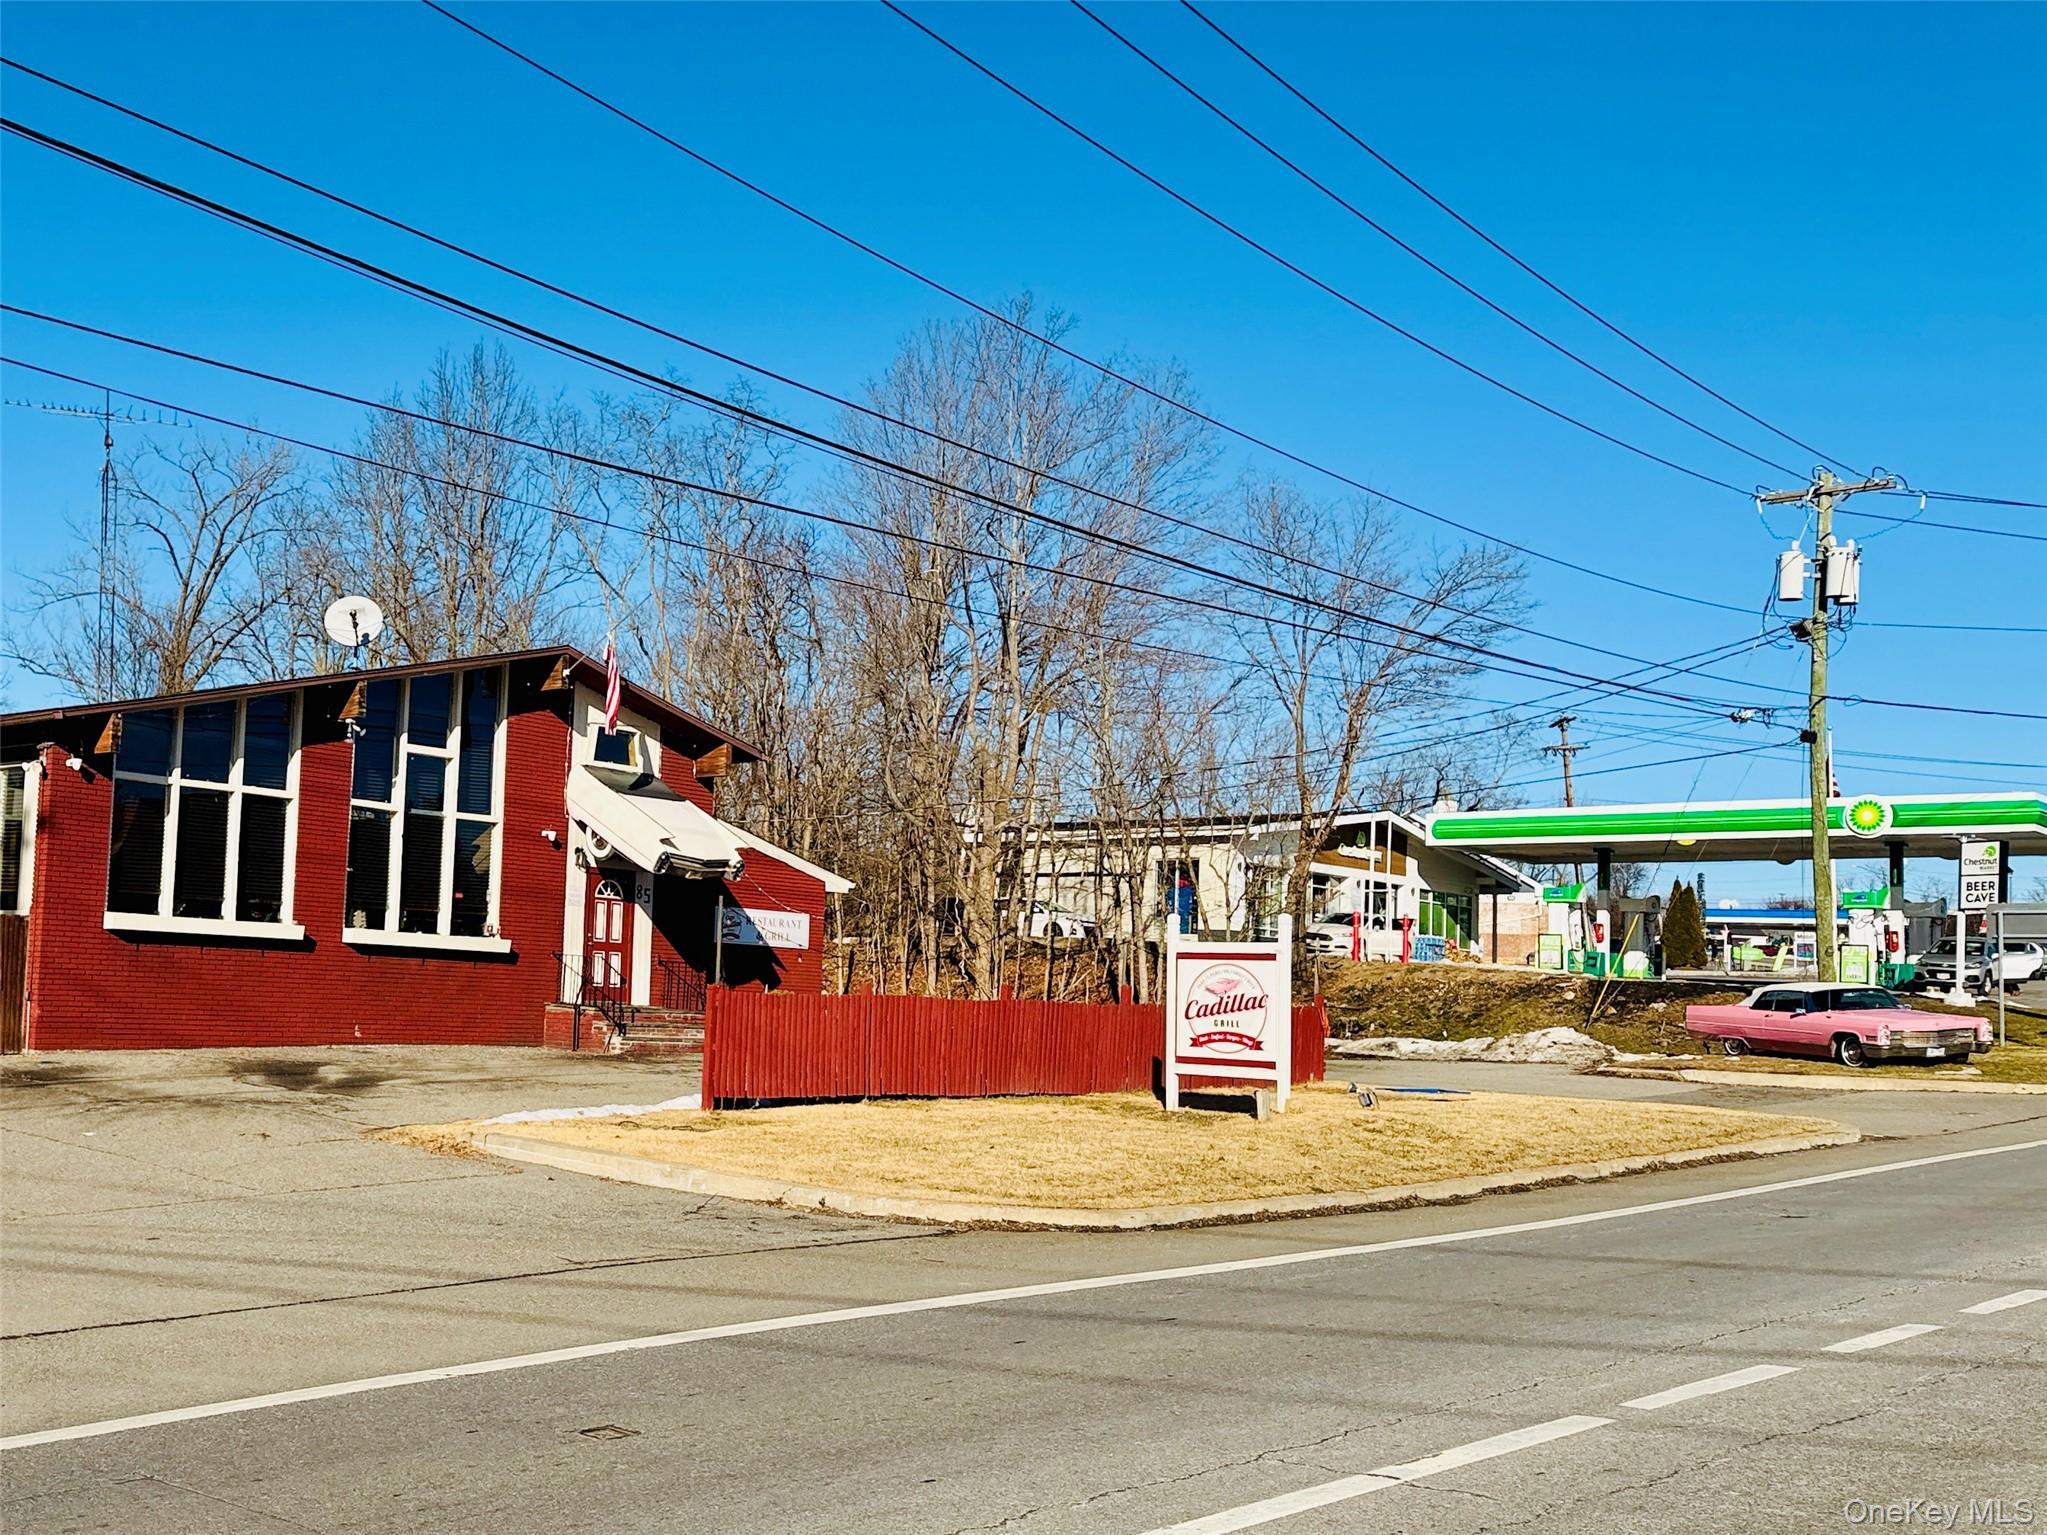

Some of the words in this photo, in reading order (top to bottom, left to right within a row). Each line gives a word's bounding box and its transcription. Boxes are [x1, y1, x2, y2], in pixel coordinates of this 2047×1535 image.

[1963, 858, 1998, 866] Chestnut
[1966, 881, 1996, 891] BEER
[636, 884, 651, 904] 85
[1965, 892, 1996, 903] CAVE
[746, 916, 803, 929] RESTAURANT
[765, 931, 790, 942] GRILL
[1184, 993, 1269, 1020] Cadillac
[1213, 1019, 1240, 1028] GRILL
